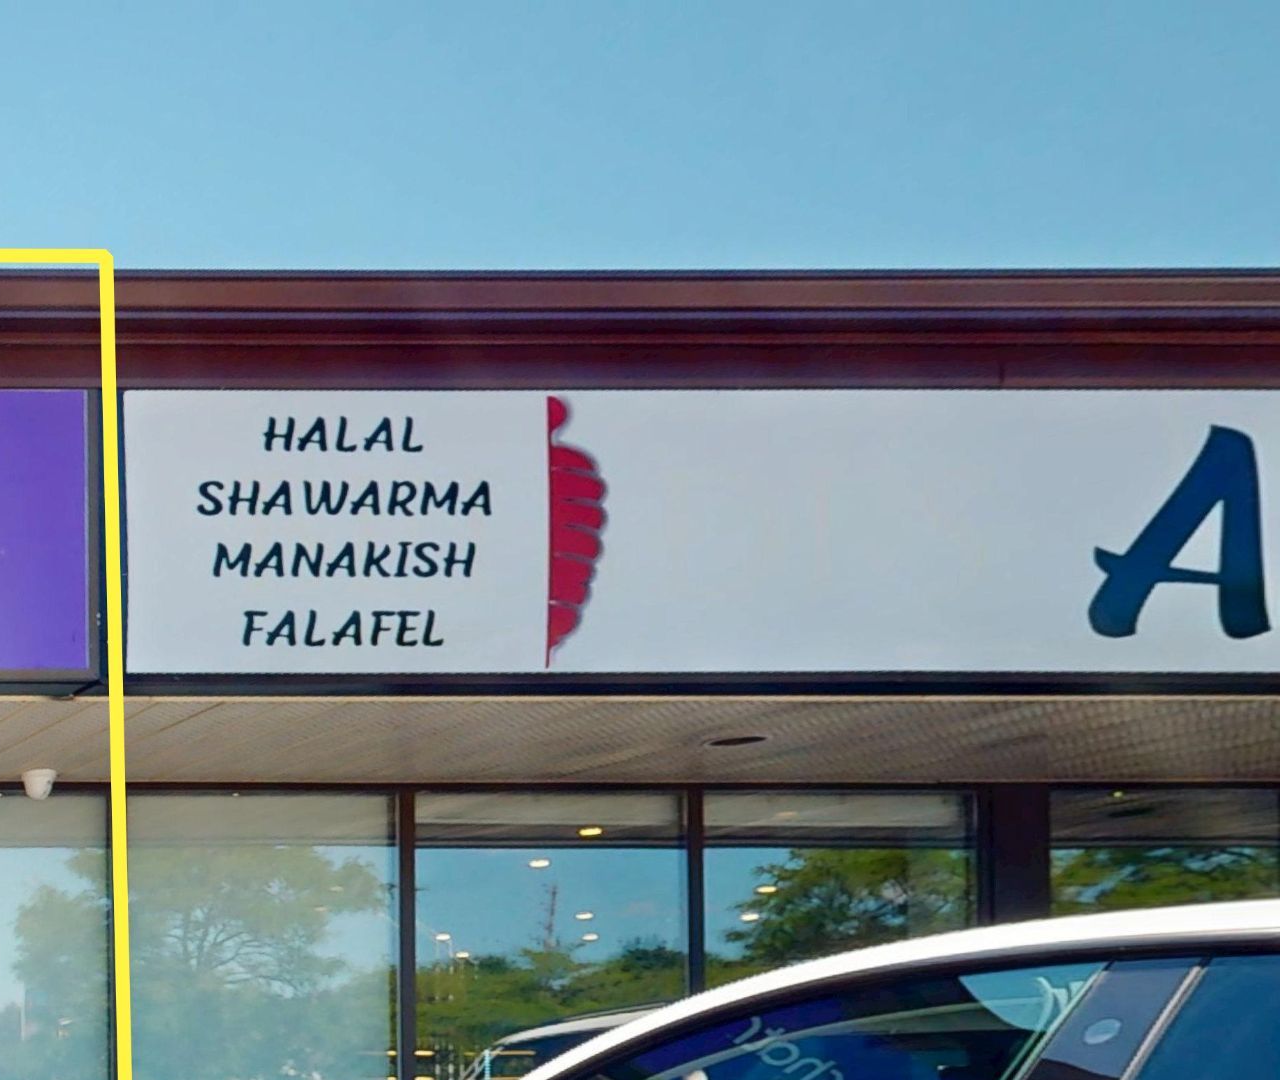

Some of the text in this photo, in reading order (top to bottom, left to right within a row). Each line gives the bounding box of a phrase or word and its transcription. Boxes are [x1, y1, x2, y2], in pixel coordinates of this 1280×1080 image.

[262, 416, 424, 452] HALAL
[196, 480, 493, 517] SHAWARMA
[1087, 423, 1273, 640] A
[212, 541, 477, 578] MANAKISH
[242, 609, 445, 648] FALAFEL
